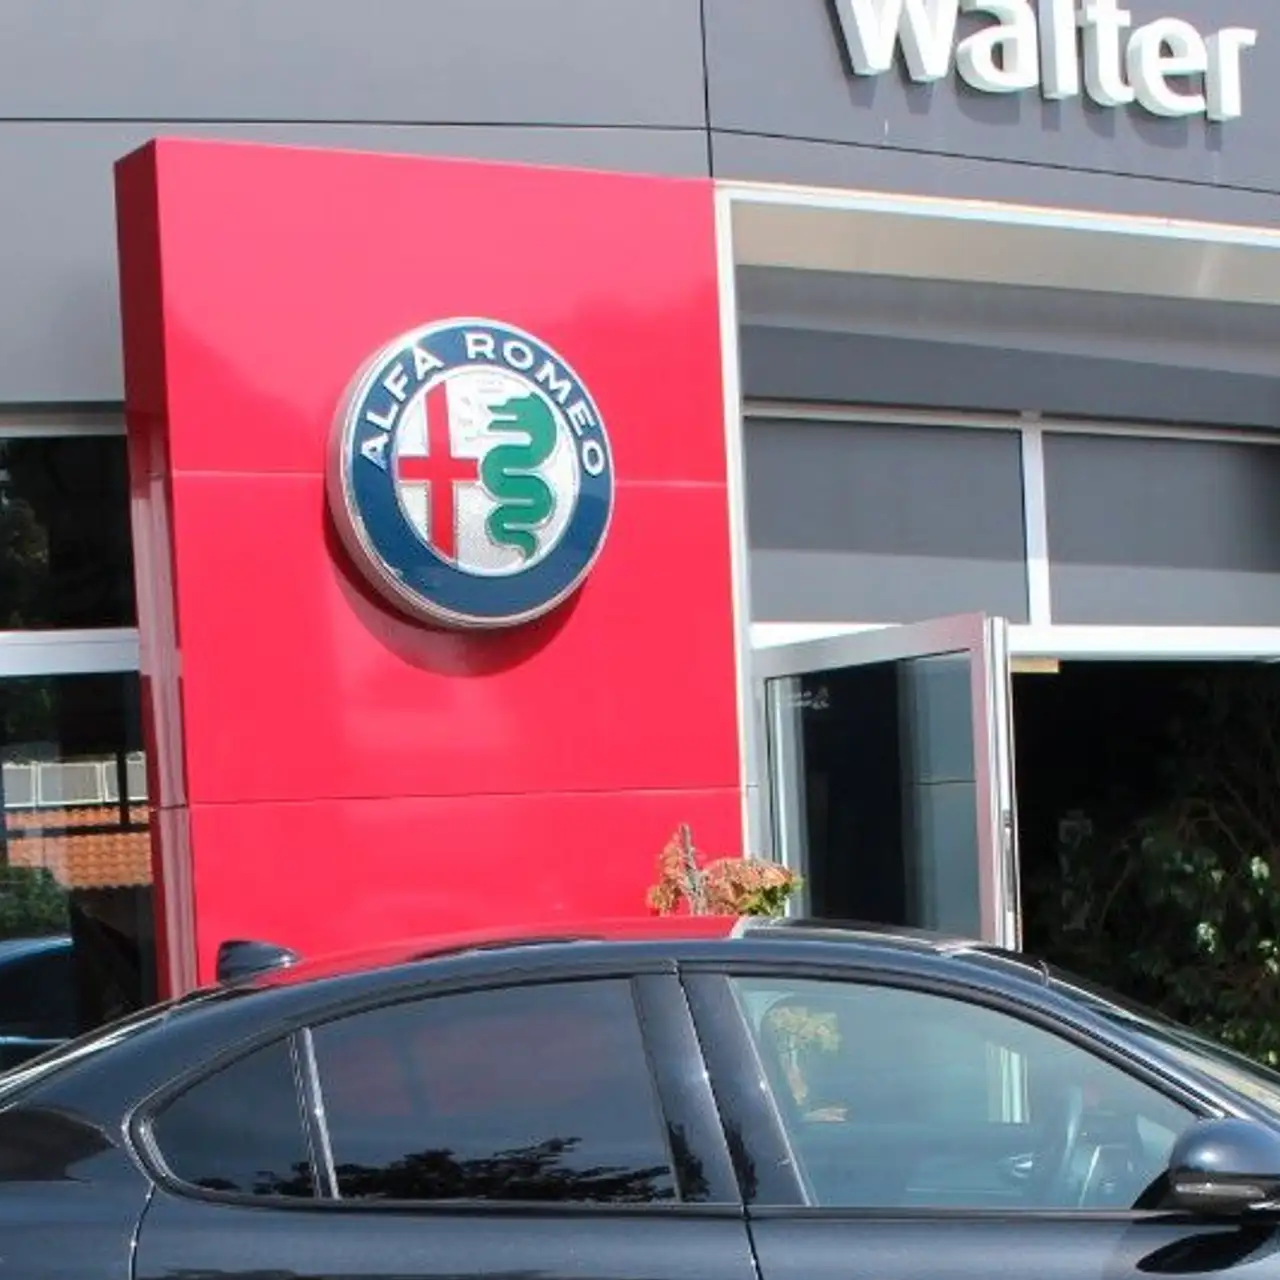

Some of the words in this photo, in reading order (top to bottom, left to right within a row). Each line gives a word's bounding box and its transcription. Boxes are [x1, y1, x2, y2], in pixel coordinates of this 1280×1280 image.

[824, 0, 1257, 121] Walter
[360, 340, 444, 470] ALFA
[464, 331, 605, 476] ROMEO
